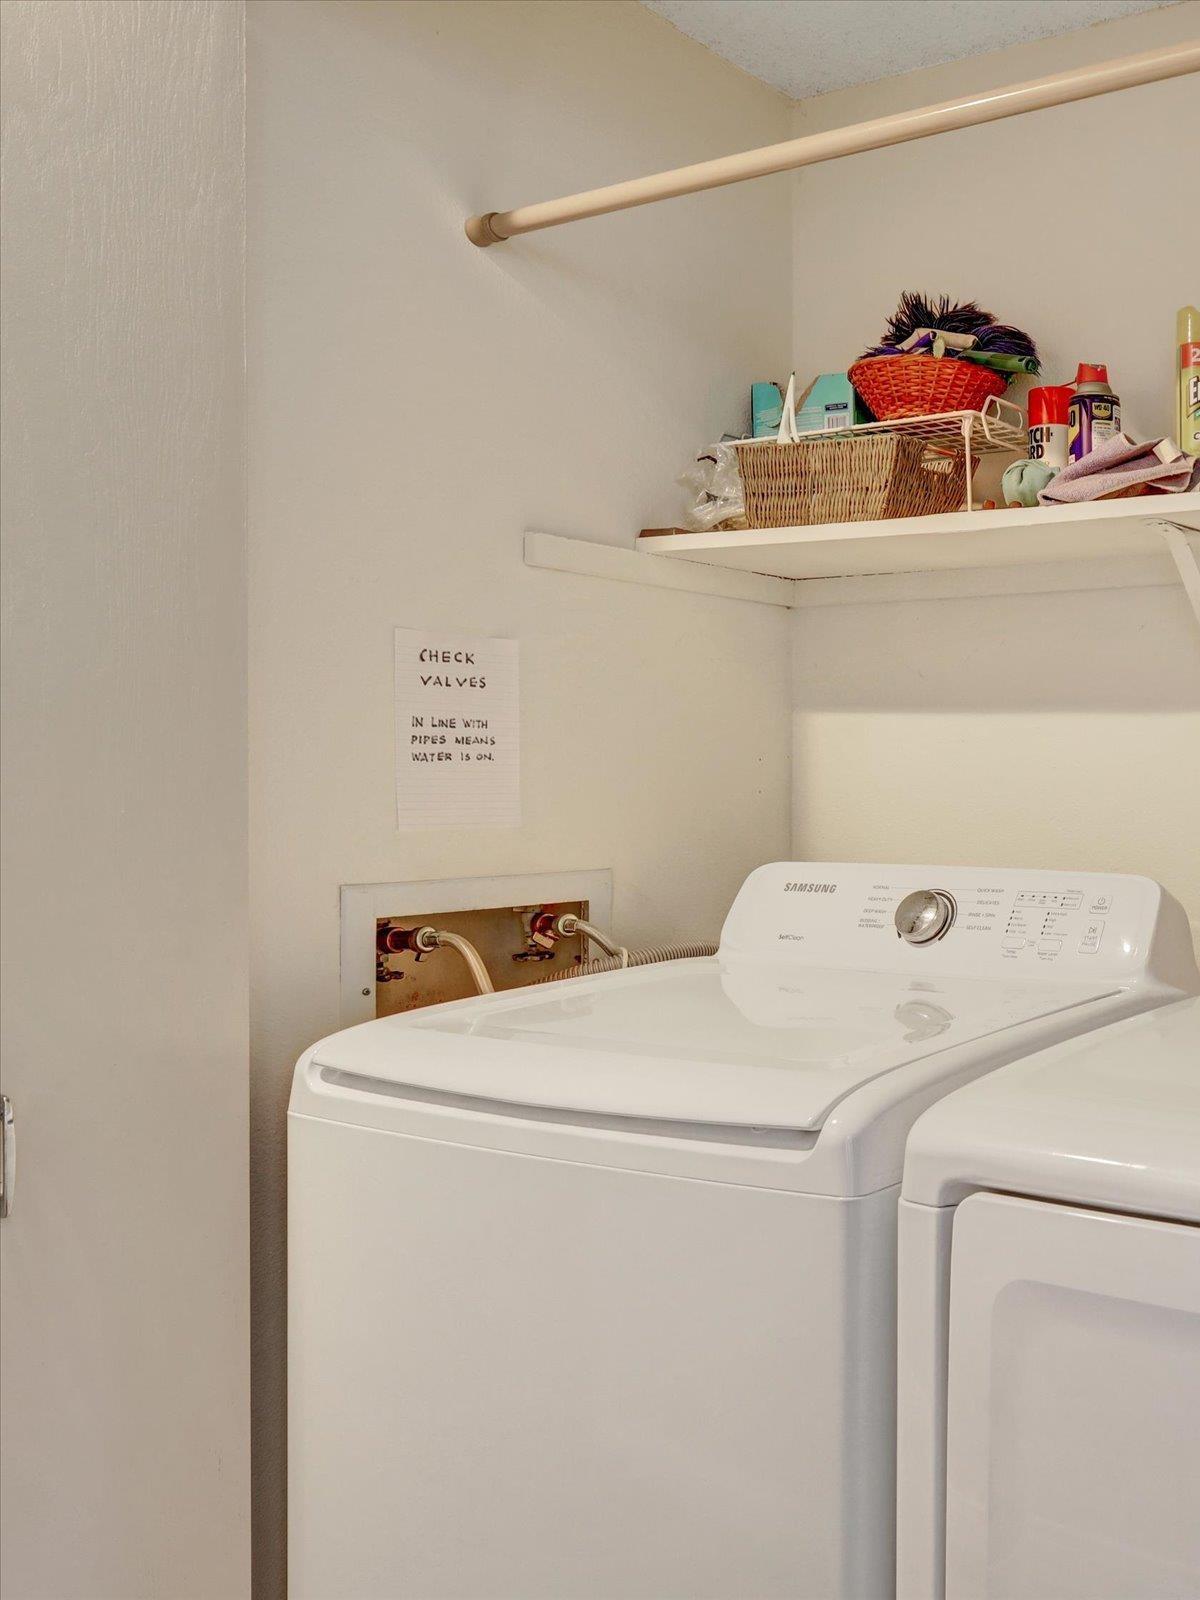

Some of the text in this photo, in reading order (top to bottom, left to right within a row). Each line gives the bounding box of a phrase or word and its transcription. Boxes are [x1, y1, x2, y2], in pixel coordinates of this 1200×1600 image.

[419, 648, 475, 665] CHECK
[420, 675, 487, 689] VALVES
[411, 715, 488, 729] IN LINE WITH
[411, 735, 496, 746] PIPES MEANS
[411, 752, 452, 762] WATER
[460, 752, 471, 761] IS
[783, 882, 838, 894] SAMSUNG
